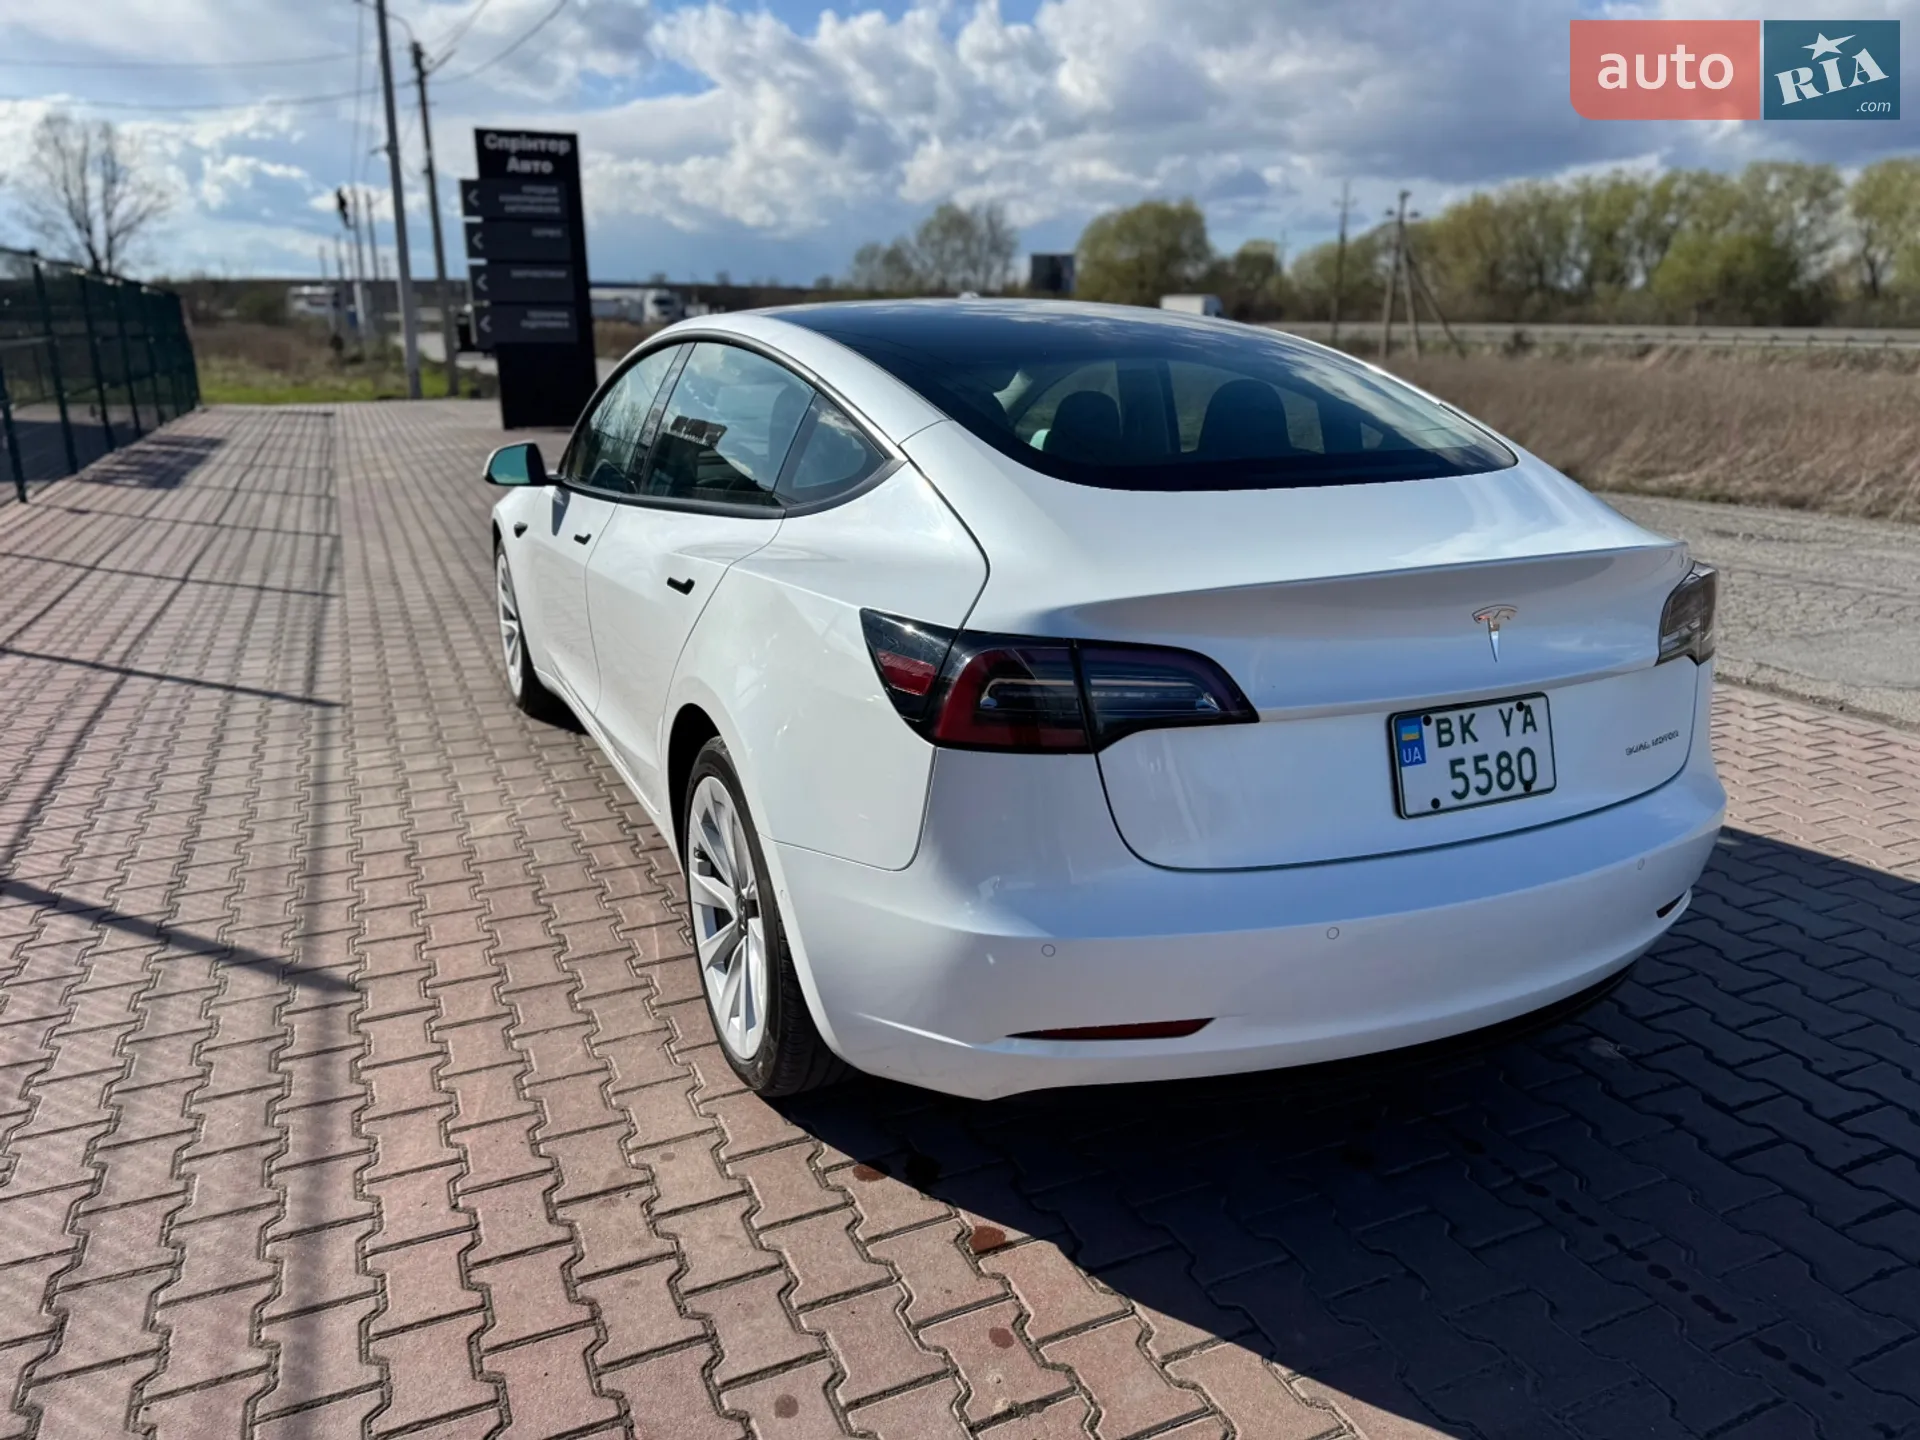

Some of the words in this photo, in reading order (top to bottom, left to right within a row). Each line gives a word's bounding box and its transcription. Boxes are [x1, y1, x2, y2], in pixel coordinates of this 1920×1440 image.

[506, 155, 553, 174] Авто
[1435, 713, 1479, 748] BK
[1498, 704, 1538, 737] YA
[1402, 747, 1423, 764] UA
[1449, 747, 1537, 800] 5580
